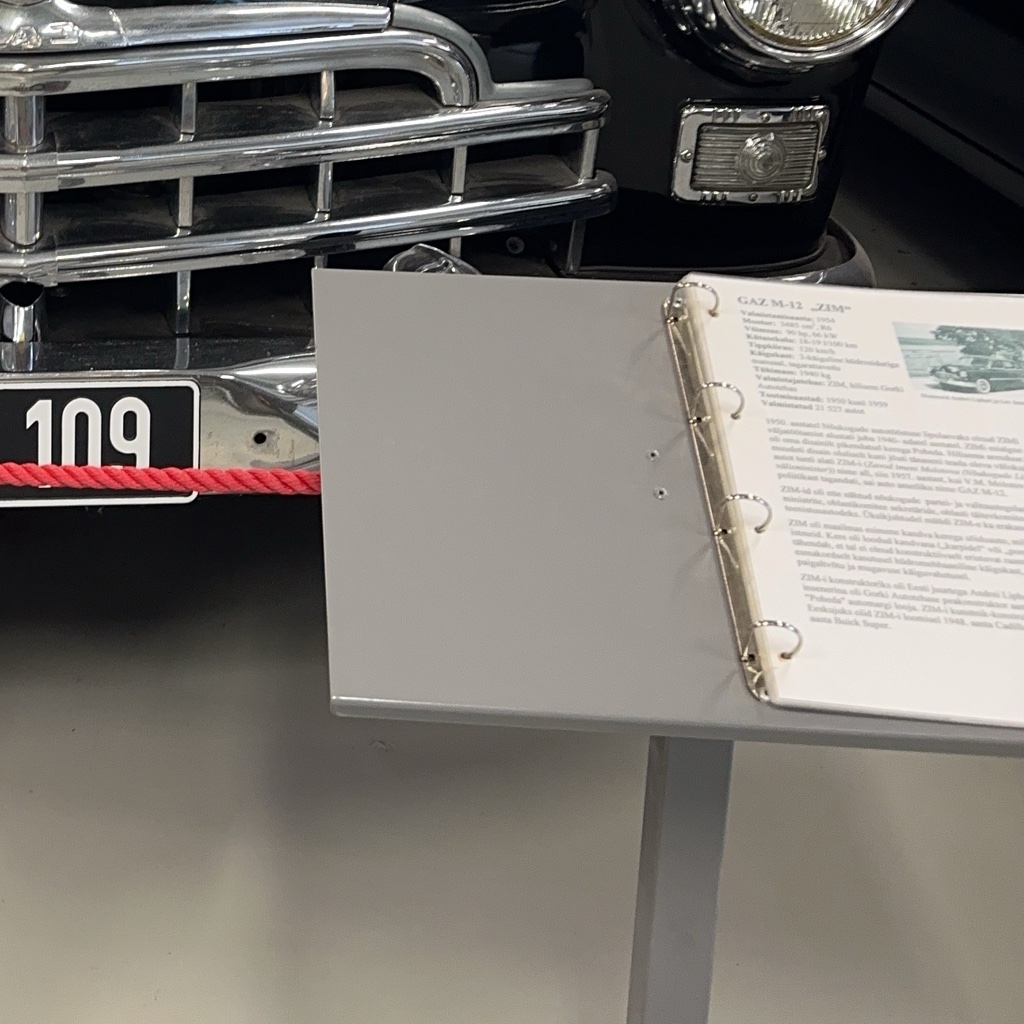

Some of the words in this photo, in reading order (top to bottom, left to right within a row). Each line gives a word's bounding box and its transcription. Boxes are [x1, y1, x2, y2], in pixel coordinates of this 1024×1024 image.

[736, 295, 768, 307] GAZ
[770, 298, 803, 310] M-12
[26, 396, 151, 488] 109
